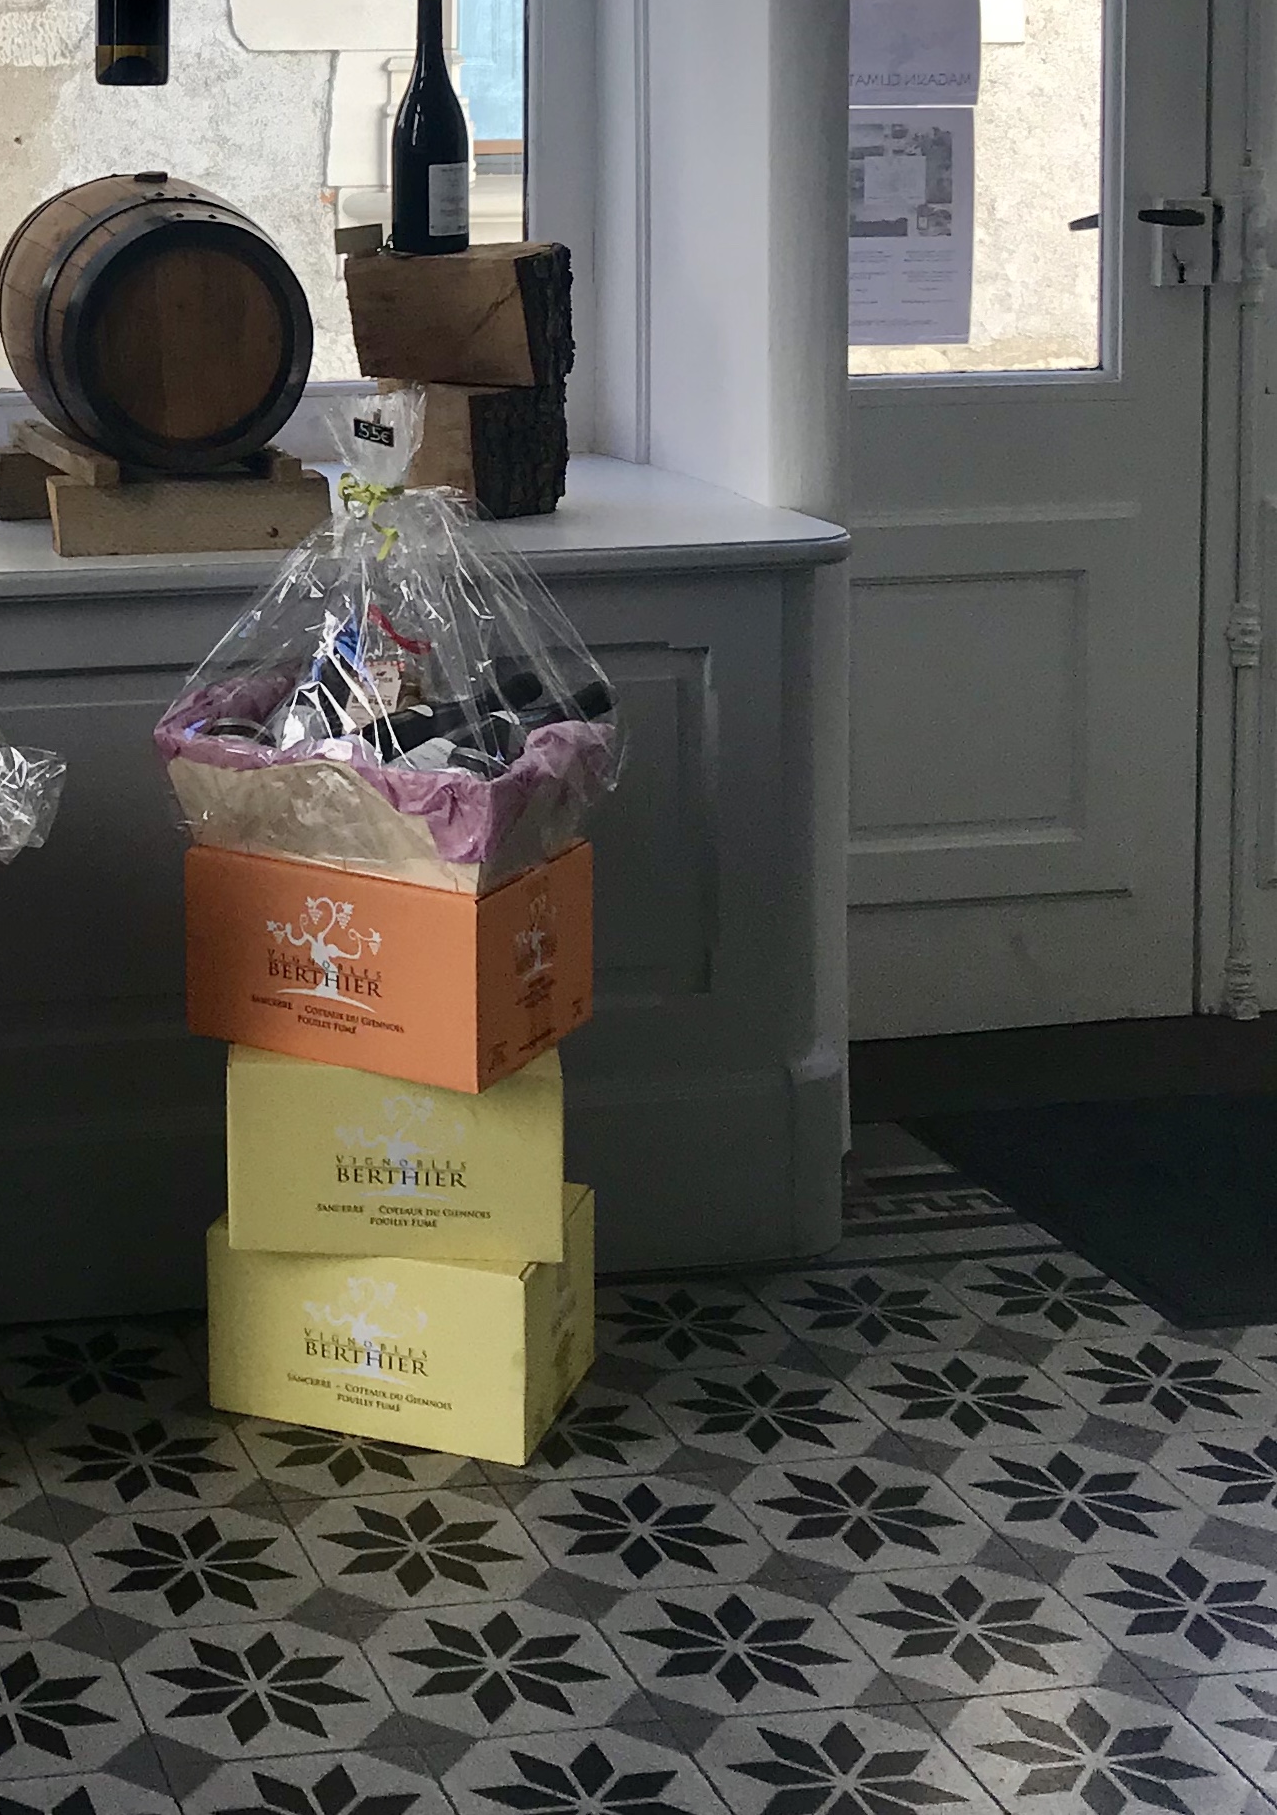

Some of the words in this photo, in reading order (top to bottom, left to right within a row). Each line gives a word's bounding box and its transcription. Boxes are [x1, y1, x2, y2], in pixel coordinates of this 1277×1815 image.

[269, 962, 383, 998] BERTHIER
[336, 1155, 466, 1171] VIGNOBLES
[338, 1167, 467, 1188] BERTHIER
[304, 1327, 427, 1358] VIGNOBLES
[306, 1341, 429, 1377] BERTHIER
